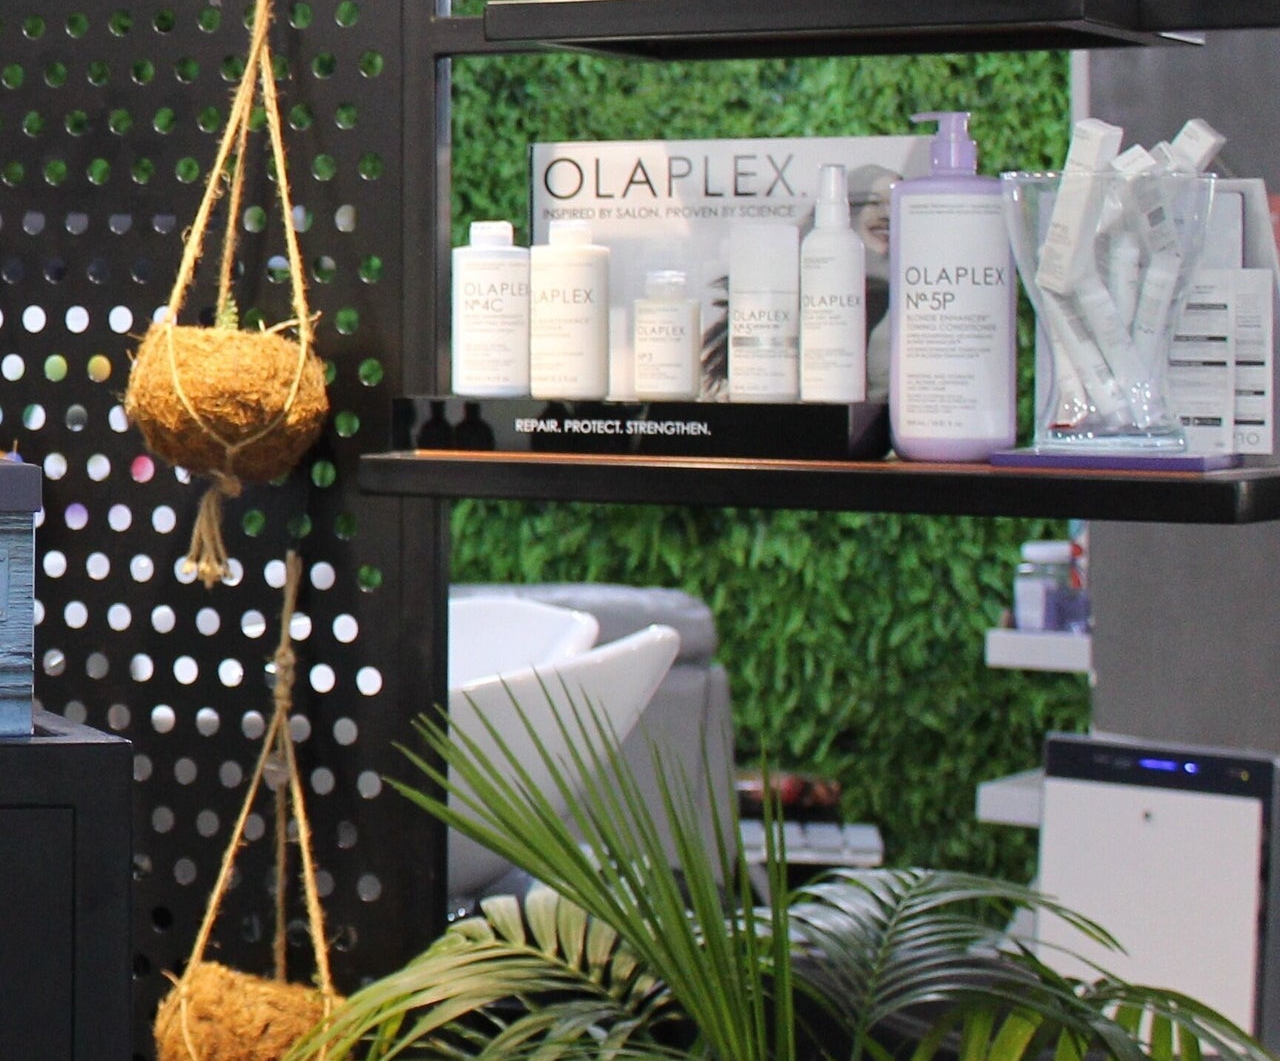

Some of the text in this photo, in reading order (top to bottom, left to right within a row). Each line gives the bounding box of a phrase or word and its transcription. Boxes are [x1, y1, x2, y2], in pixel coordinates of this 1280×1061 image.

[543, 207, 596, 221] INSPIRED
[599, 207, 614, 220] BY
[665, 205, 720, 219] PROVEN
[722, 204, 737, 218] BY
[739, 203, 797, 218] SCIENCE
[905, 266, 1006, 286] OLAPLEX
[464, 283, 530, 298] OLAPLE
[733, 309, 790, 322] OLAPLEX
[638, 325, 686, 336] OLAPLEX
[515, 418, 711, 436] REPAIR. PROTECT. STRENGTHEN.
